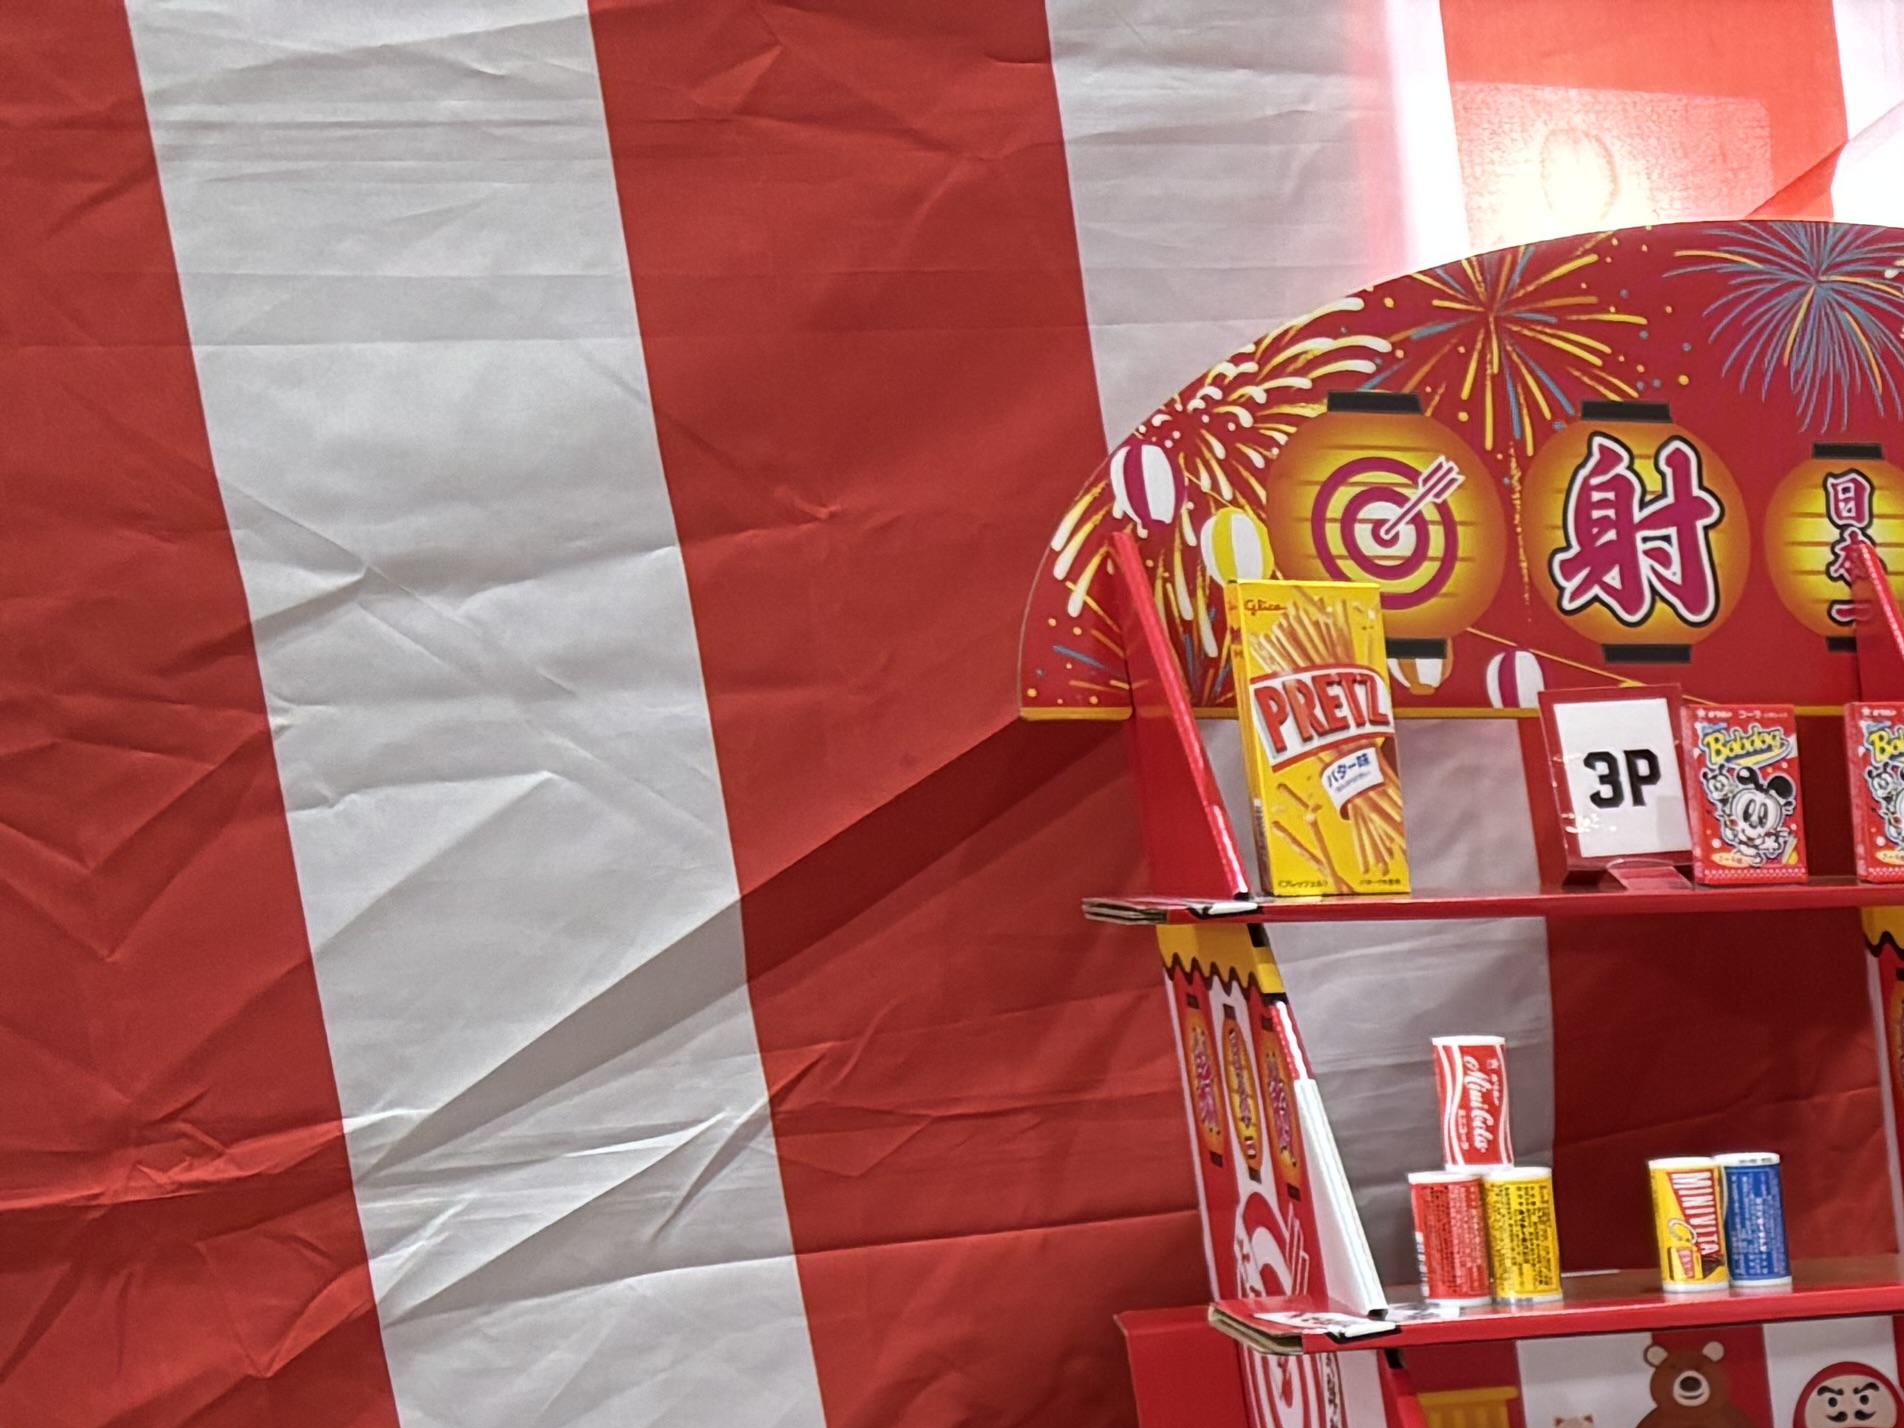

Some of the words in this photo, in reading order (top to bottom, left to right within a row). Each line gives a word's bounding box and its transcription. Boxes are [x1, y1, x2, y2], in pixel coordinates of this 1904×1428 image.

[1547, 434, 1722, 627] 射
[1254, 672, 1390, 753] PRETZ
[1584, 749, 1661, 809] 3P
